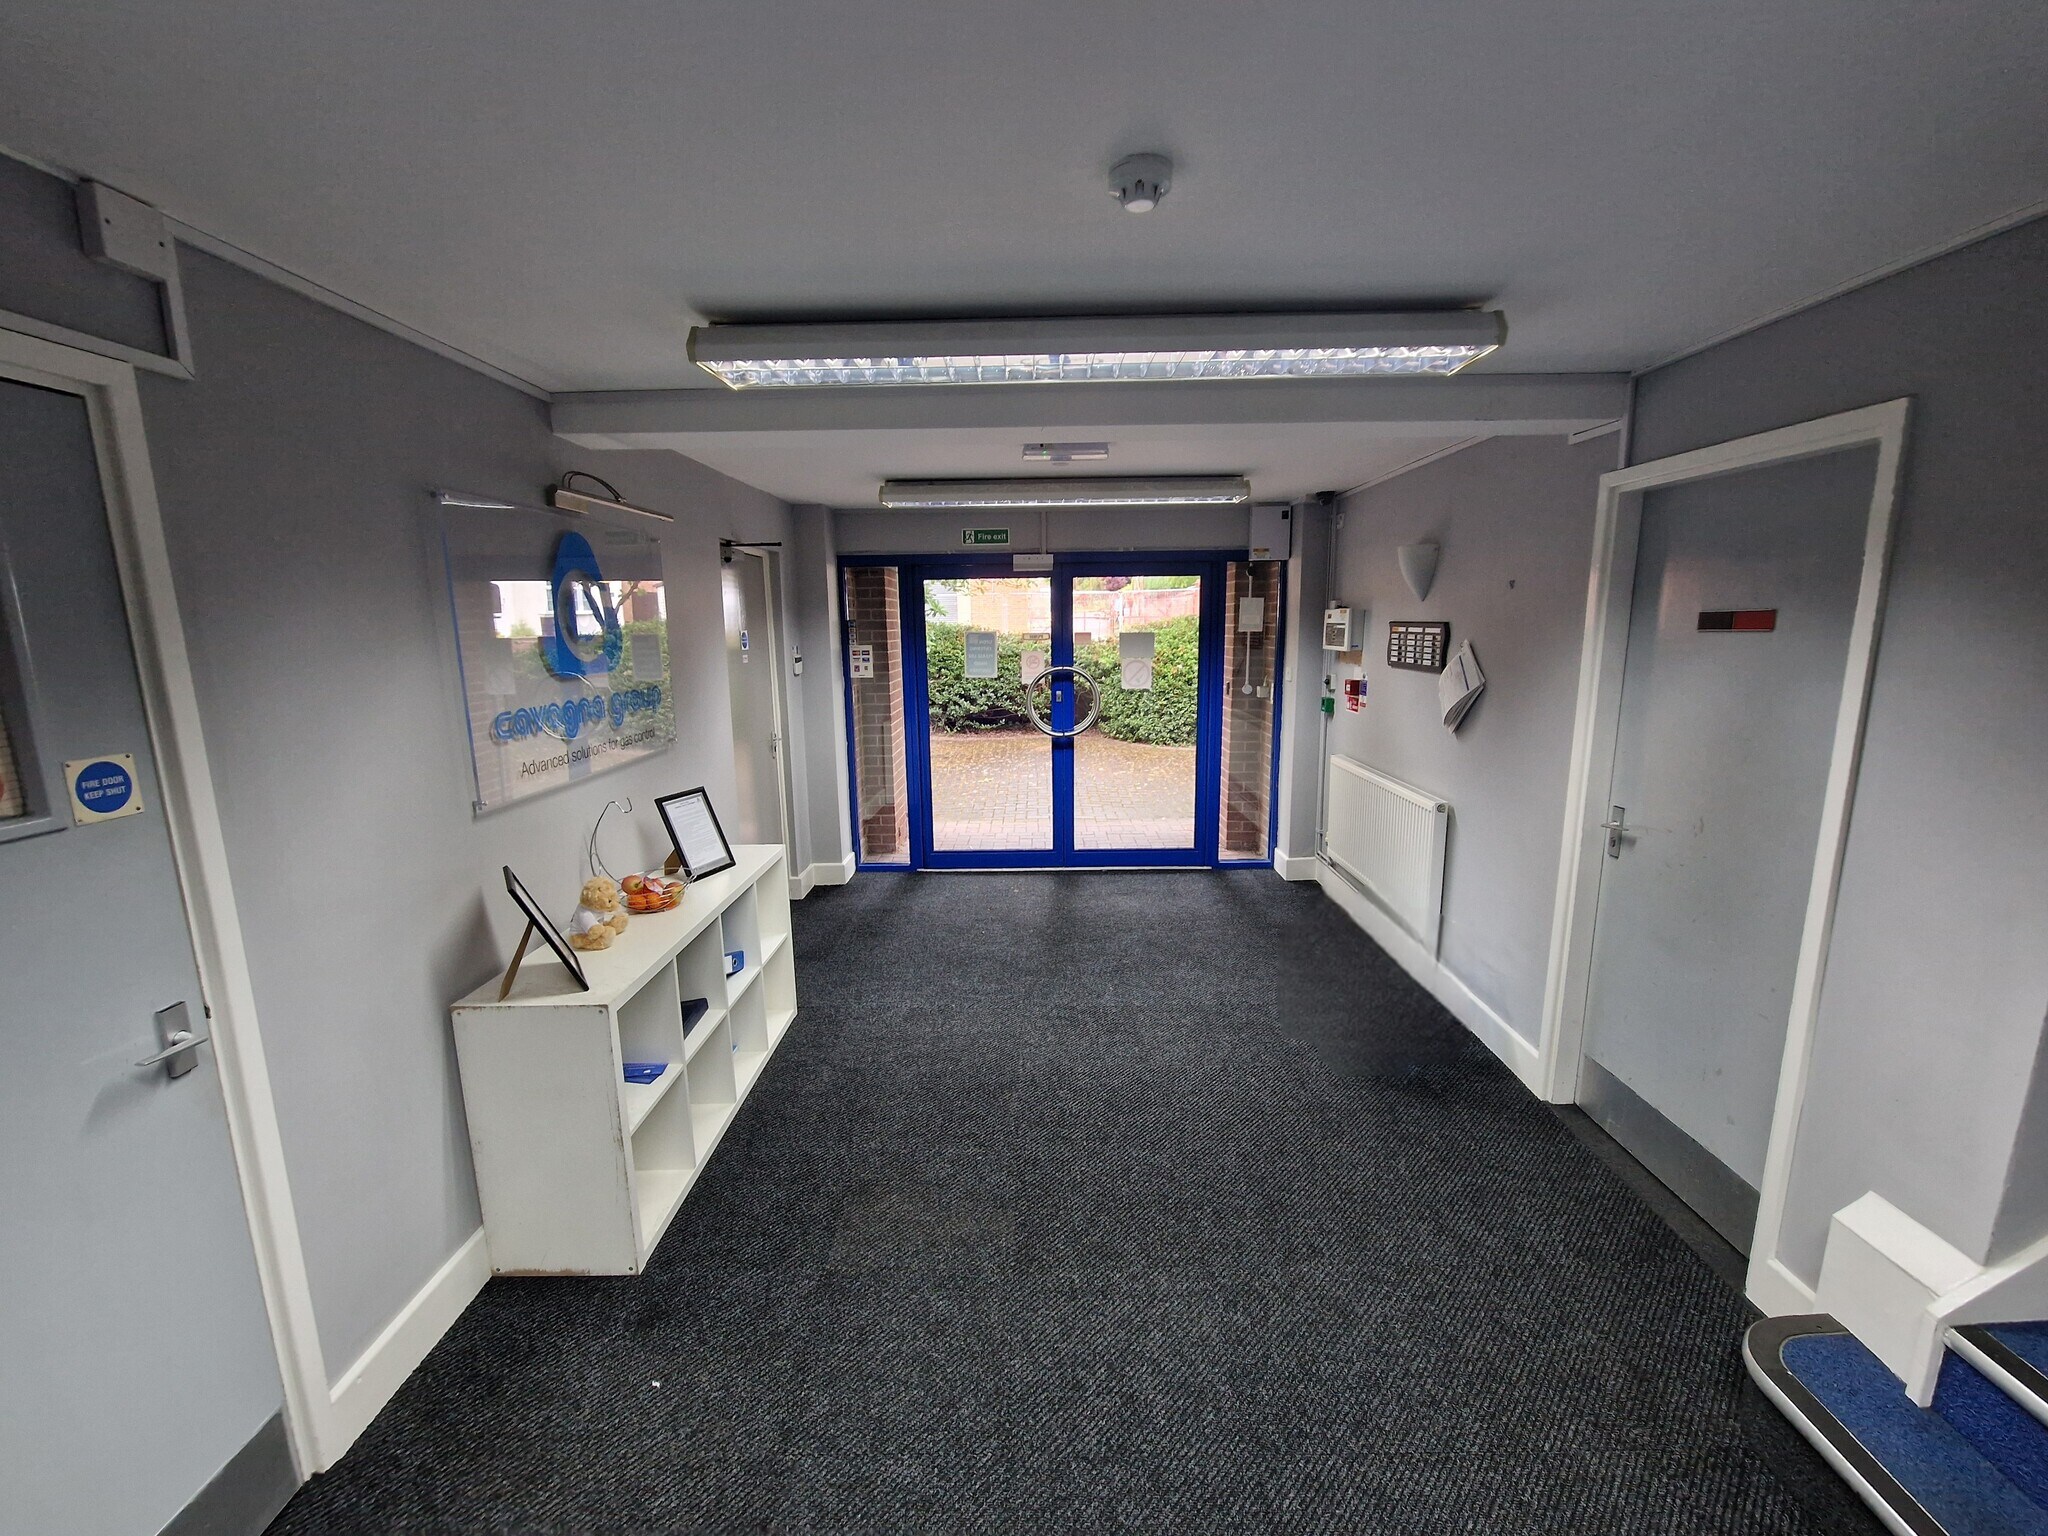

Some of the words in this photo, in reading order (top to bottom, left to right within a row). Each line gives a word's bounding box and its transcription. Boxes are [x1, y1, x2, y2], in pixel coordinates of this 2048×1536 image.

[494, 695, 606, 739] cavagna
[608, 685, 662, 728] group
[521, 750, 570, 777] Advanced
[571, 741, 608, 763] solutions
[608, 738, 619, 750] for
[620, 736, 633, 750] gas
[633, 727, 656, 743] control
[82, 779, 101, 789] FIRE
[102, 775, 124, 786] DOOR
[84, 790, 104, 800] KEEP
[106, 785, 126, 796] SHUT
